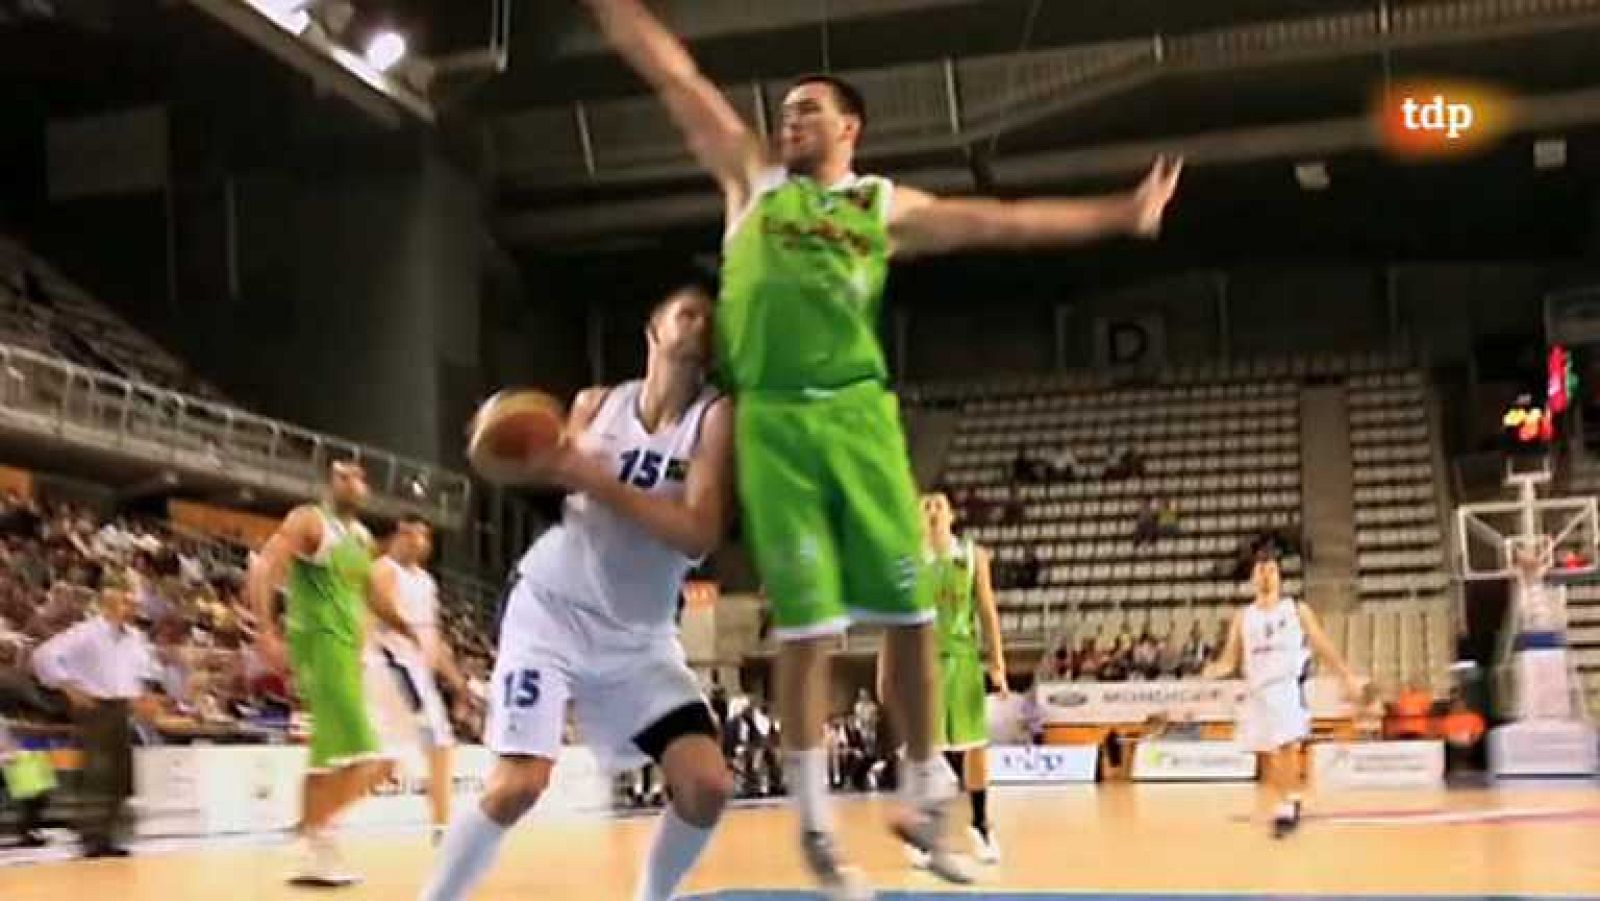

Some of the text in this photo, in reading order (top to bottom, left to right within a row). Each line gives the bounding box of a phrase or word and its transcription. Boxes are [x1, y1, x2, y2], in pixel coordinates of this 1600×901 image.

[1109, 321, 1146, 363] D
[619, 448, 662, 488] 15
[503, 669, 540, 709] 15
